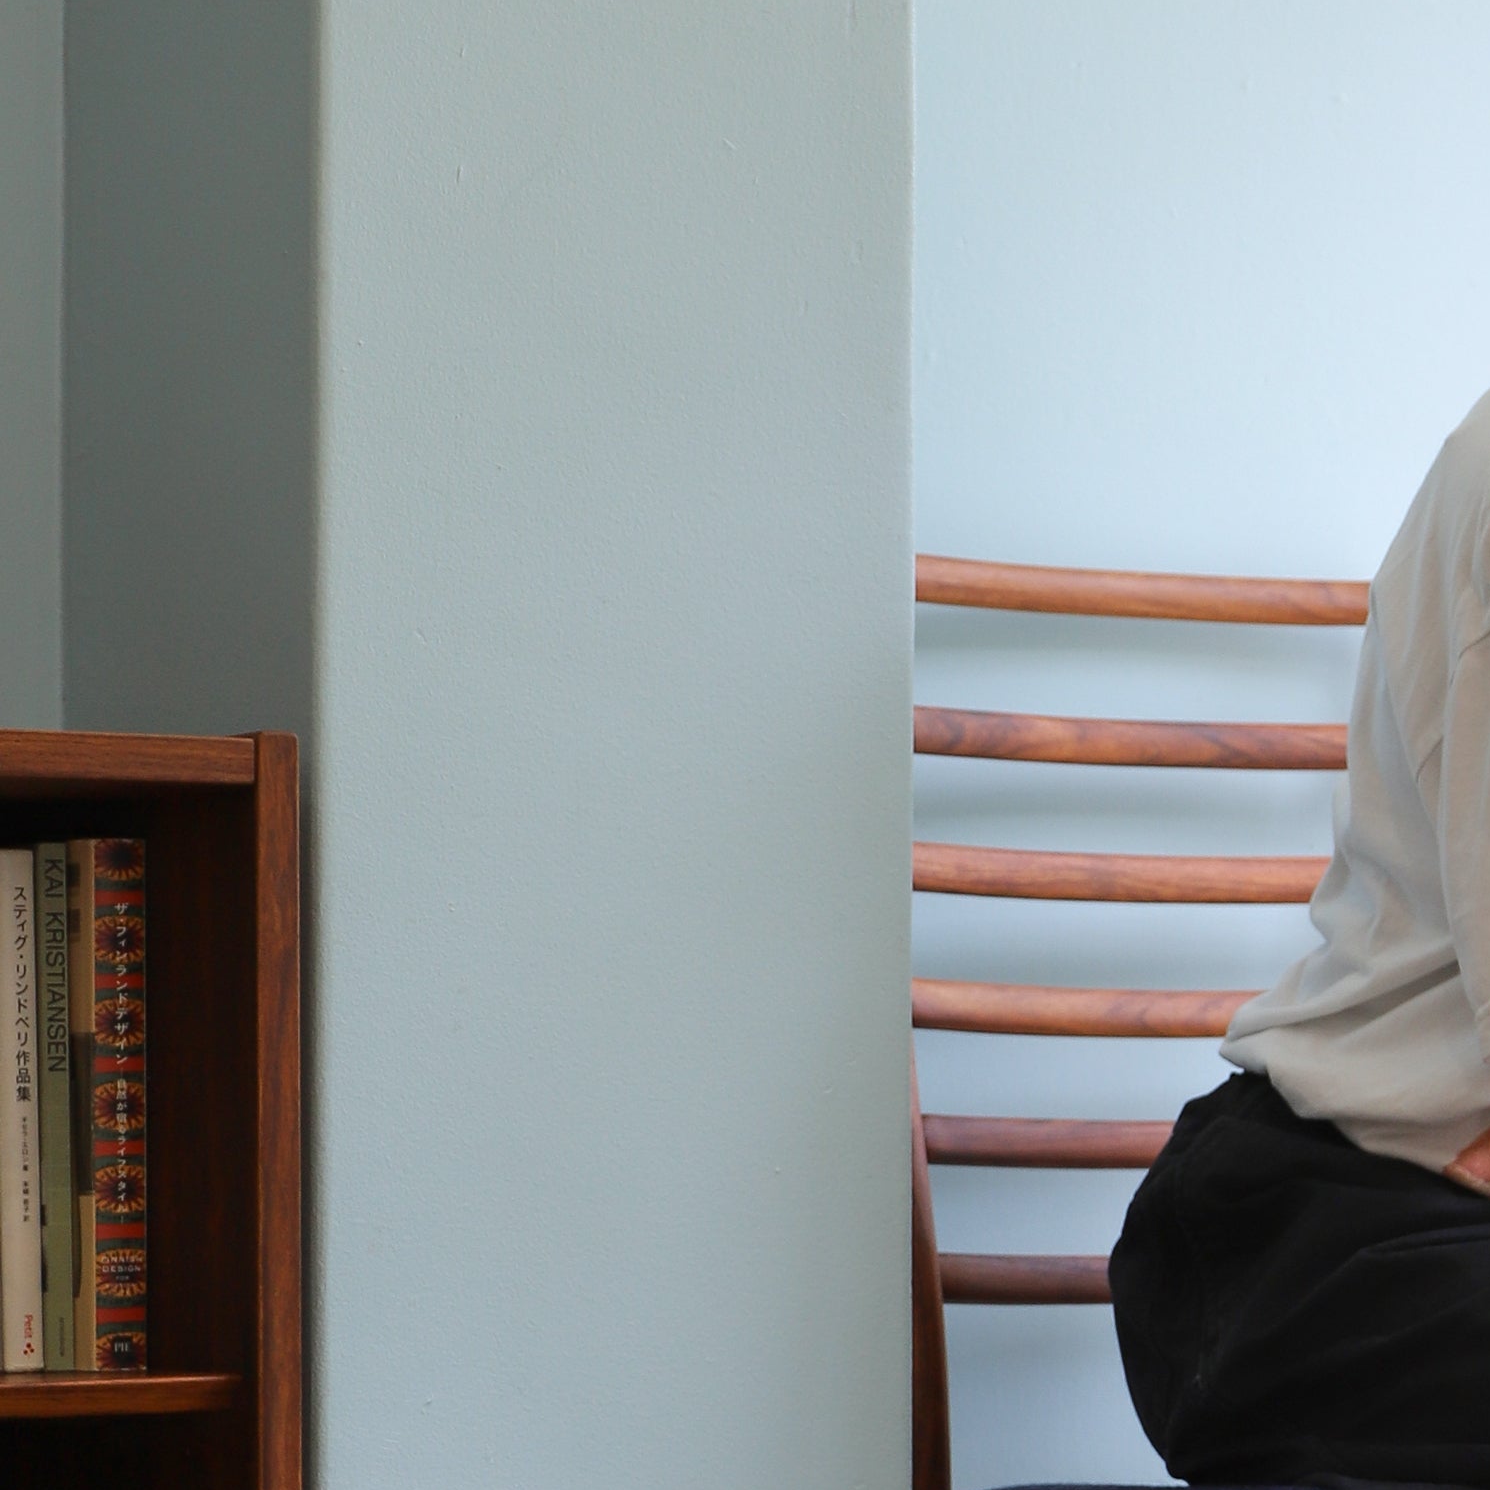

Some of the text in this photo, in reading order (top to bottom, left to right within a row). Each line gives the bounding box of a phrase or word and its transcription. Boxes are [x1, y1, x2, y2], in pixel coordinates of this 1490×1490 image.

[13, 886, 31, 1102] スティグ・リンドベリ作品集
[44, 858, 67, 1073] KAI KRISTIANSEN
[102, 1265, 141, 1273] DESIGN
